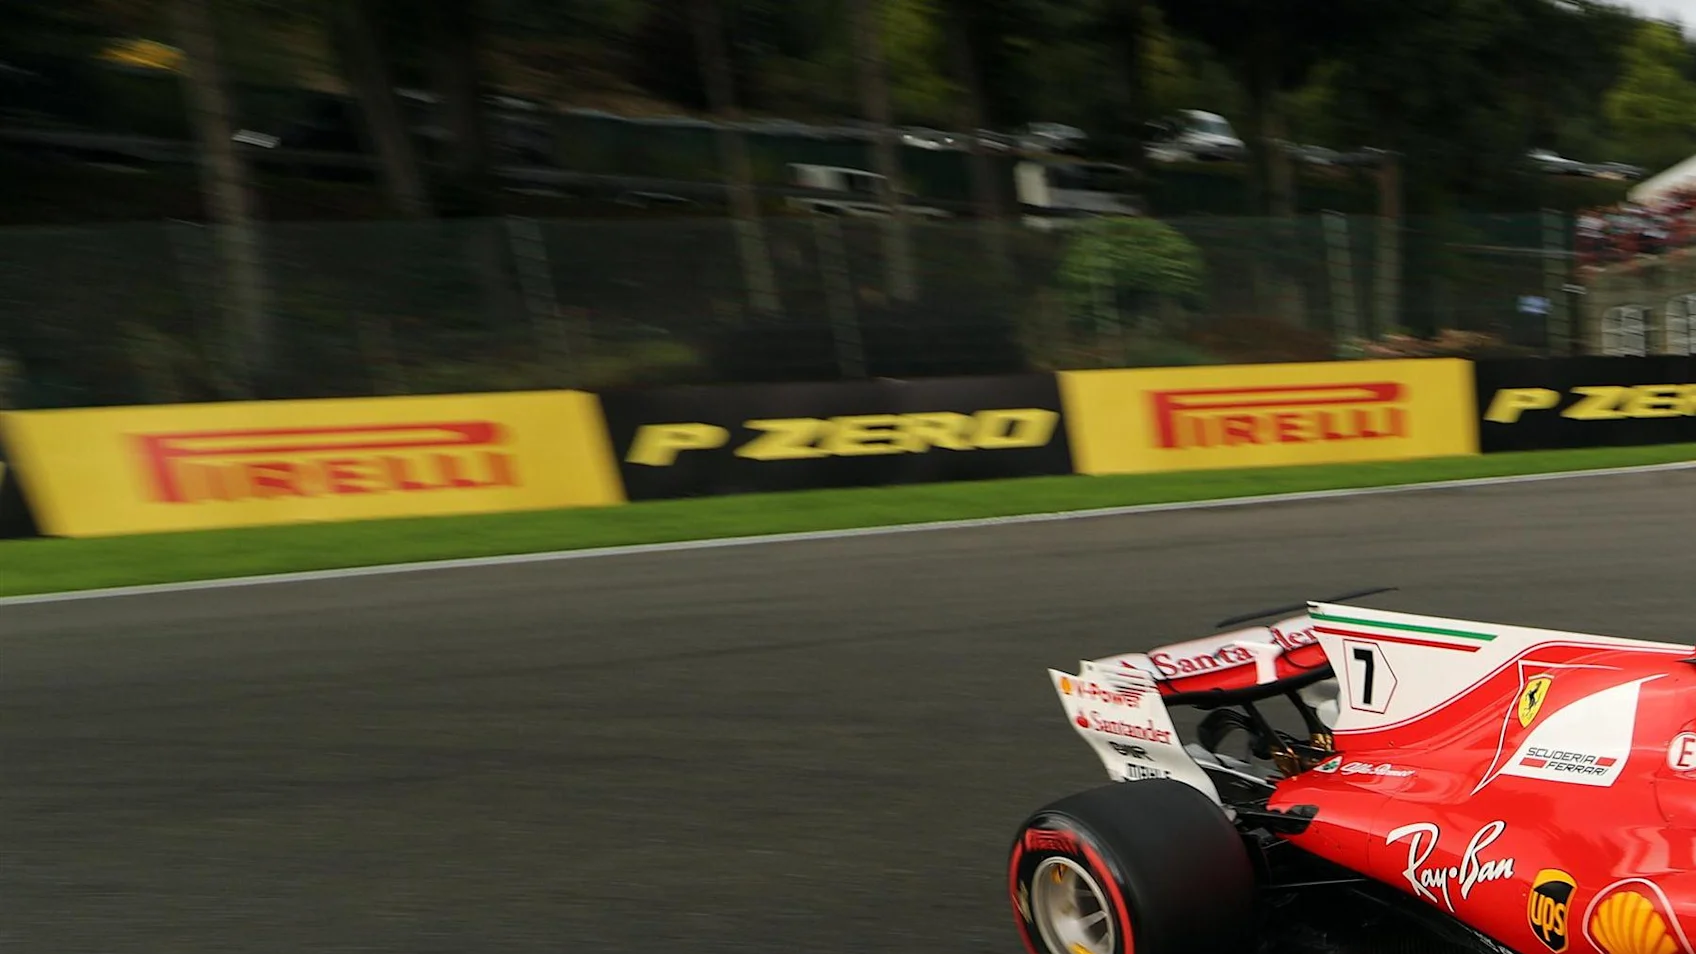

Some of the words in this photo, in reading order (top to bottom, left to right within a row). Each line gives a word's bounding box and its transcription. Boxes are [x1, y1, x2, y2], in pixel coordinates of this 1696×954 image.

[1147, 382, 1411, 450] PIRELLI
[1484, 387, 1560, 424] P
[626, 422, 729, 466] P
[734, 408, 1060, 461] ZERO
[130, 421, 520, 503] PIRELLI
[1353, 648, 1374, 705] 7
[1090, 711, 1171, 744] Santander
[1526, 747, 1596, 764] SCUDERIA
[1545, 761, 1609, 776] FERRARI
[1680, 739, 1696, 767] E
